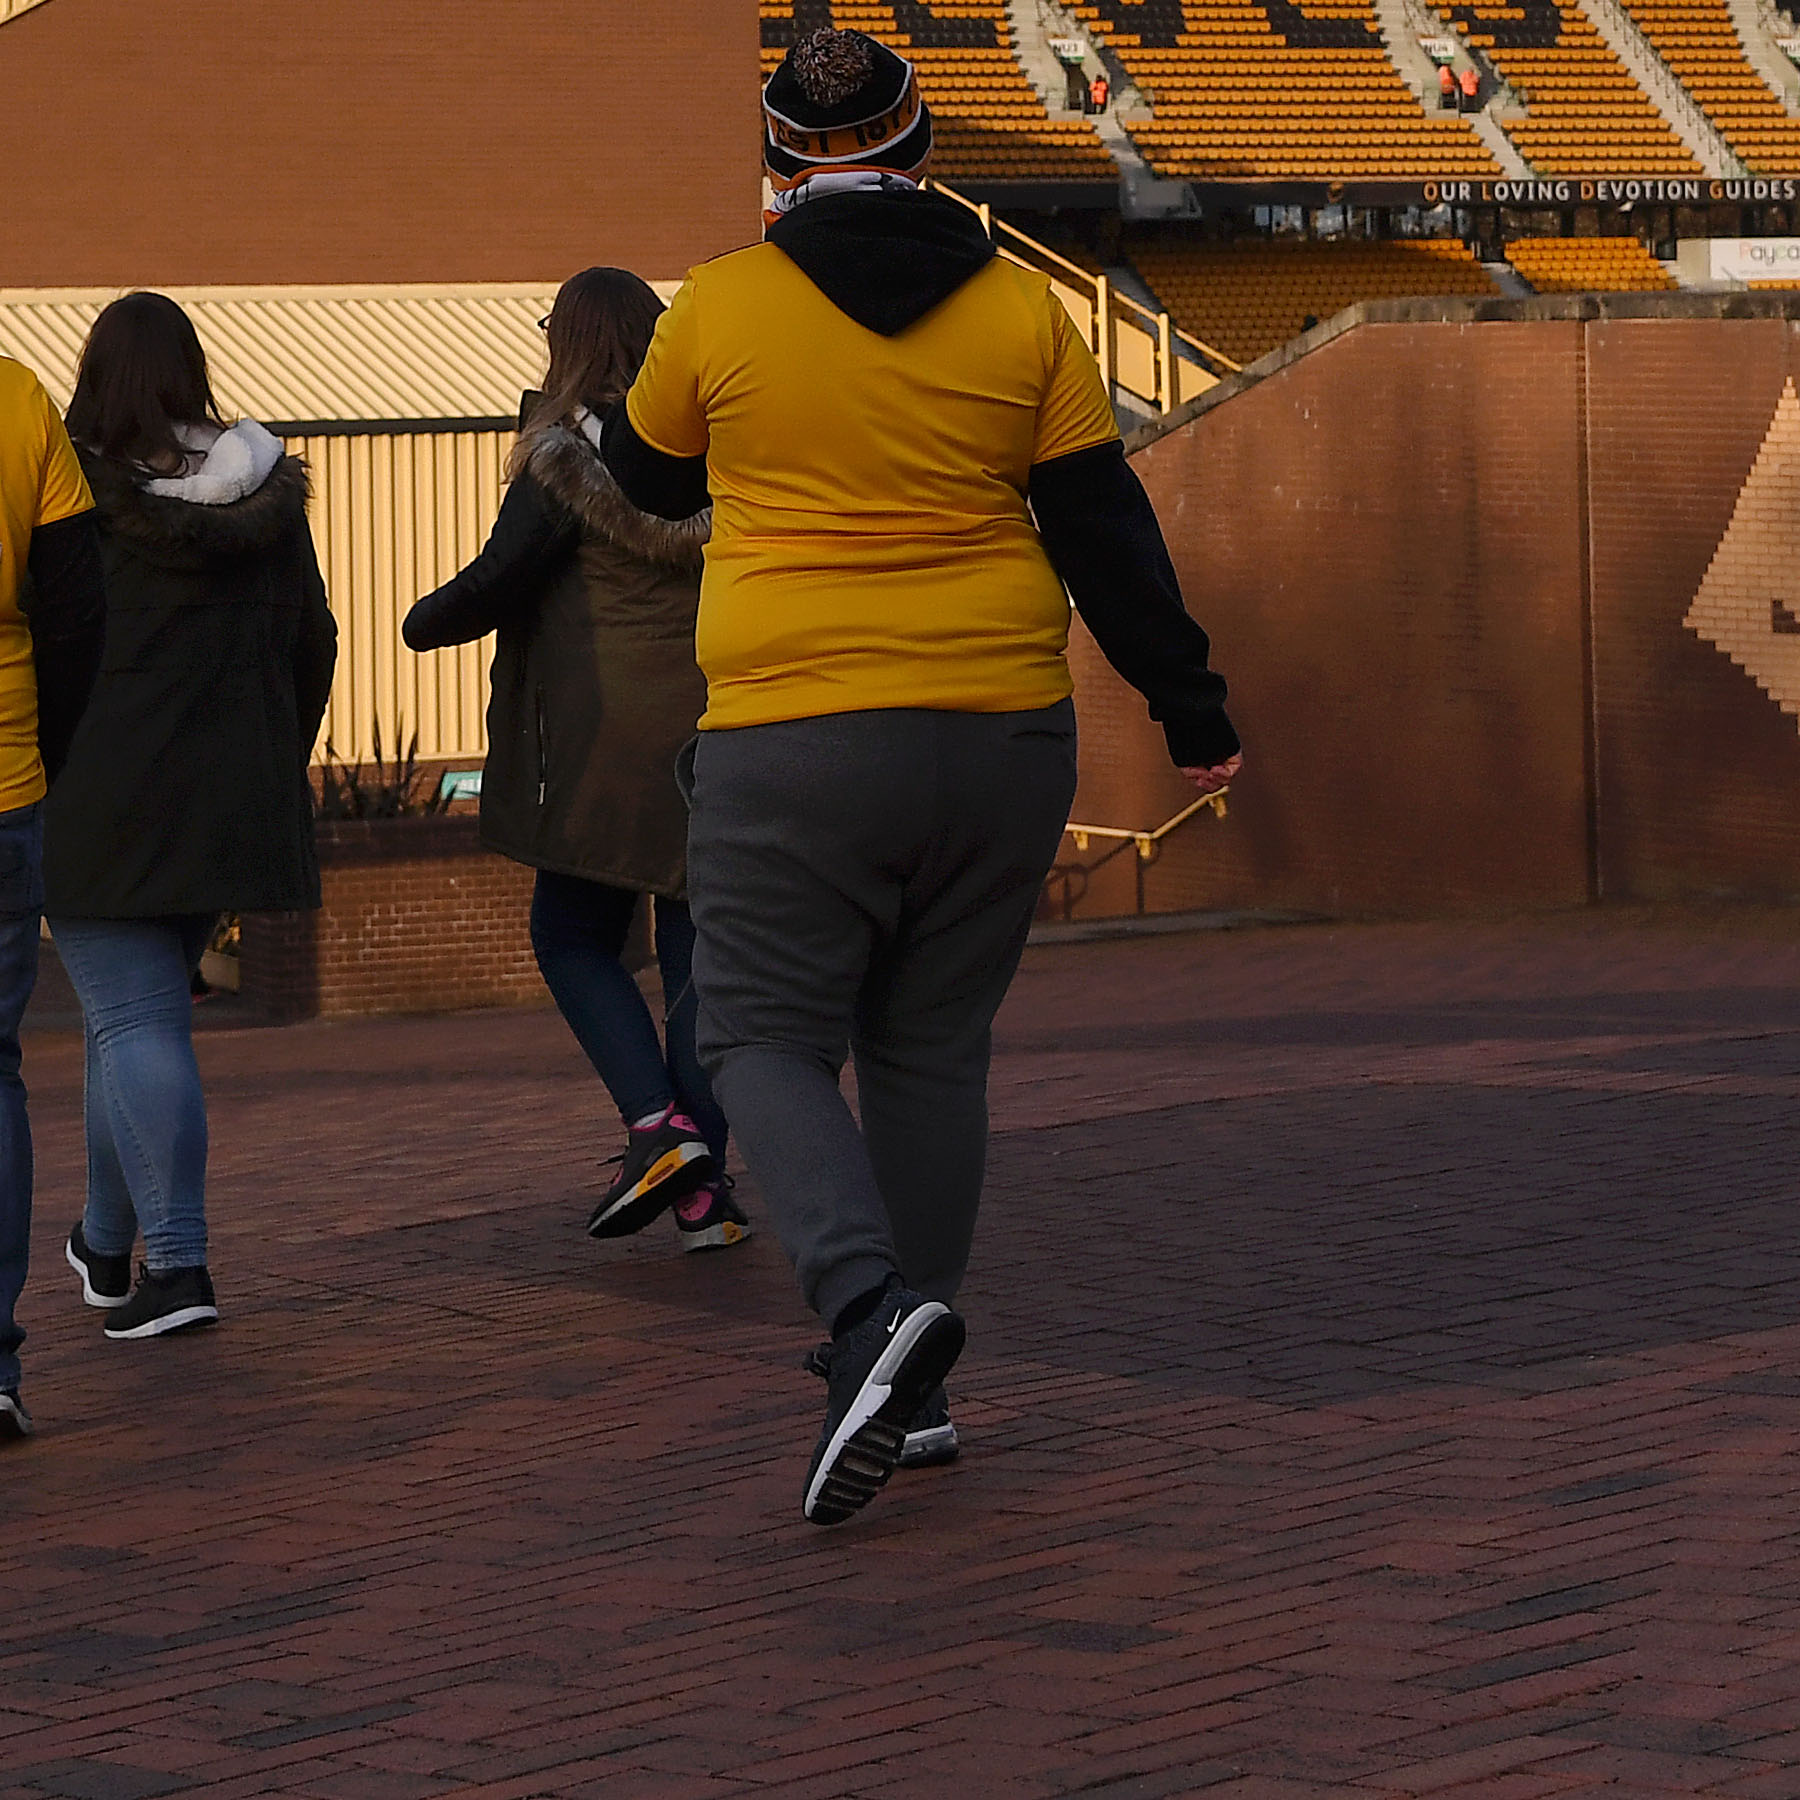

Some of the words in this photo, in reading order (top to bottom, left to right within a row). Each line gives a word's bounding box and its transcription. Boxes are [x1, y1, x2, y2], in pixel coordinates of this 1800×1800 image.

[1423, 180, 1471, 201] OUR
[1481, 180, 1570, 201] LOVING
[1580, 179, 1699, 200] DEVOTION
[1708, 179, 1796, 199] GUIDES
